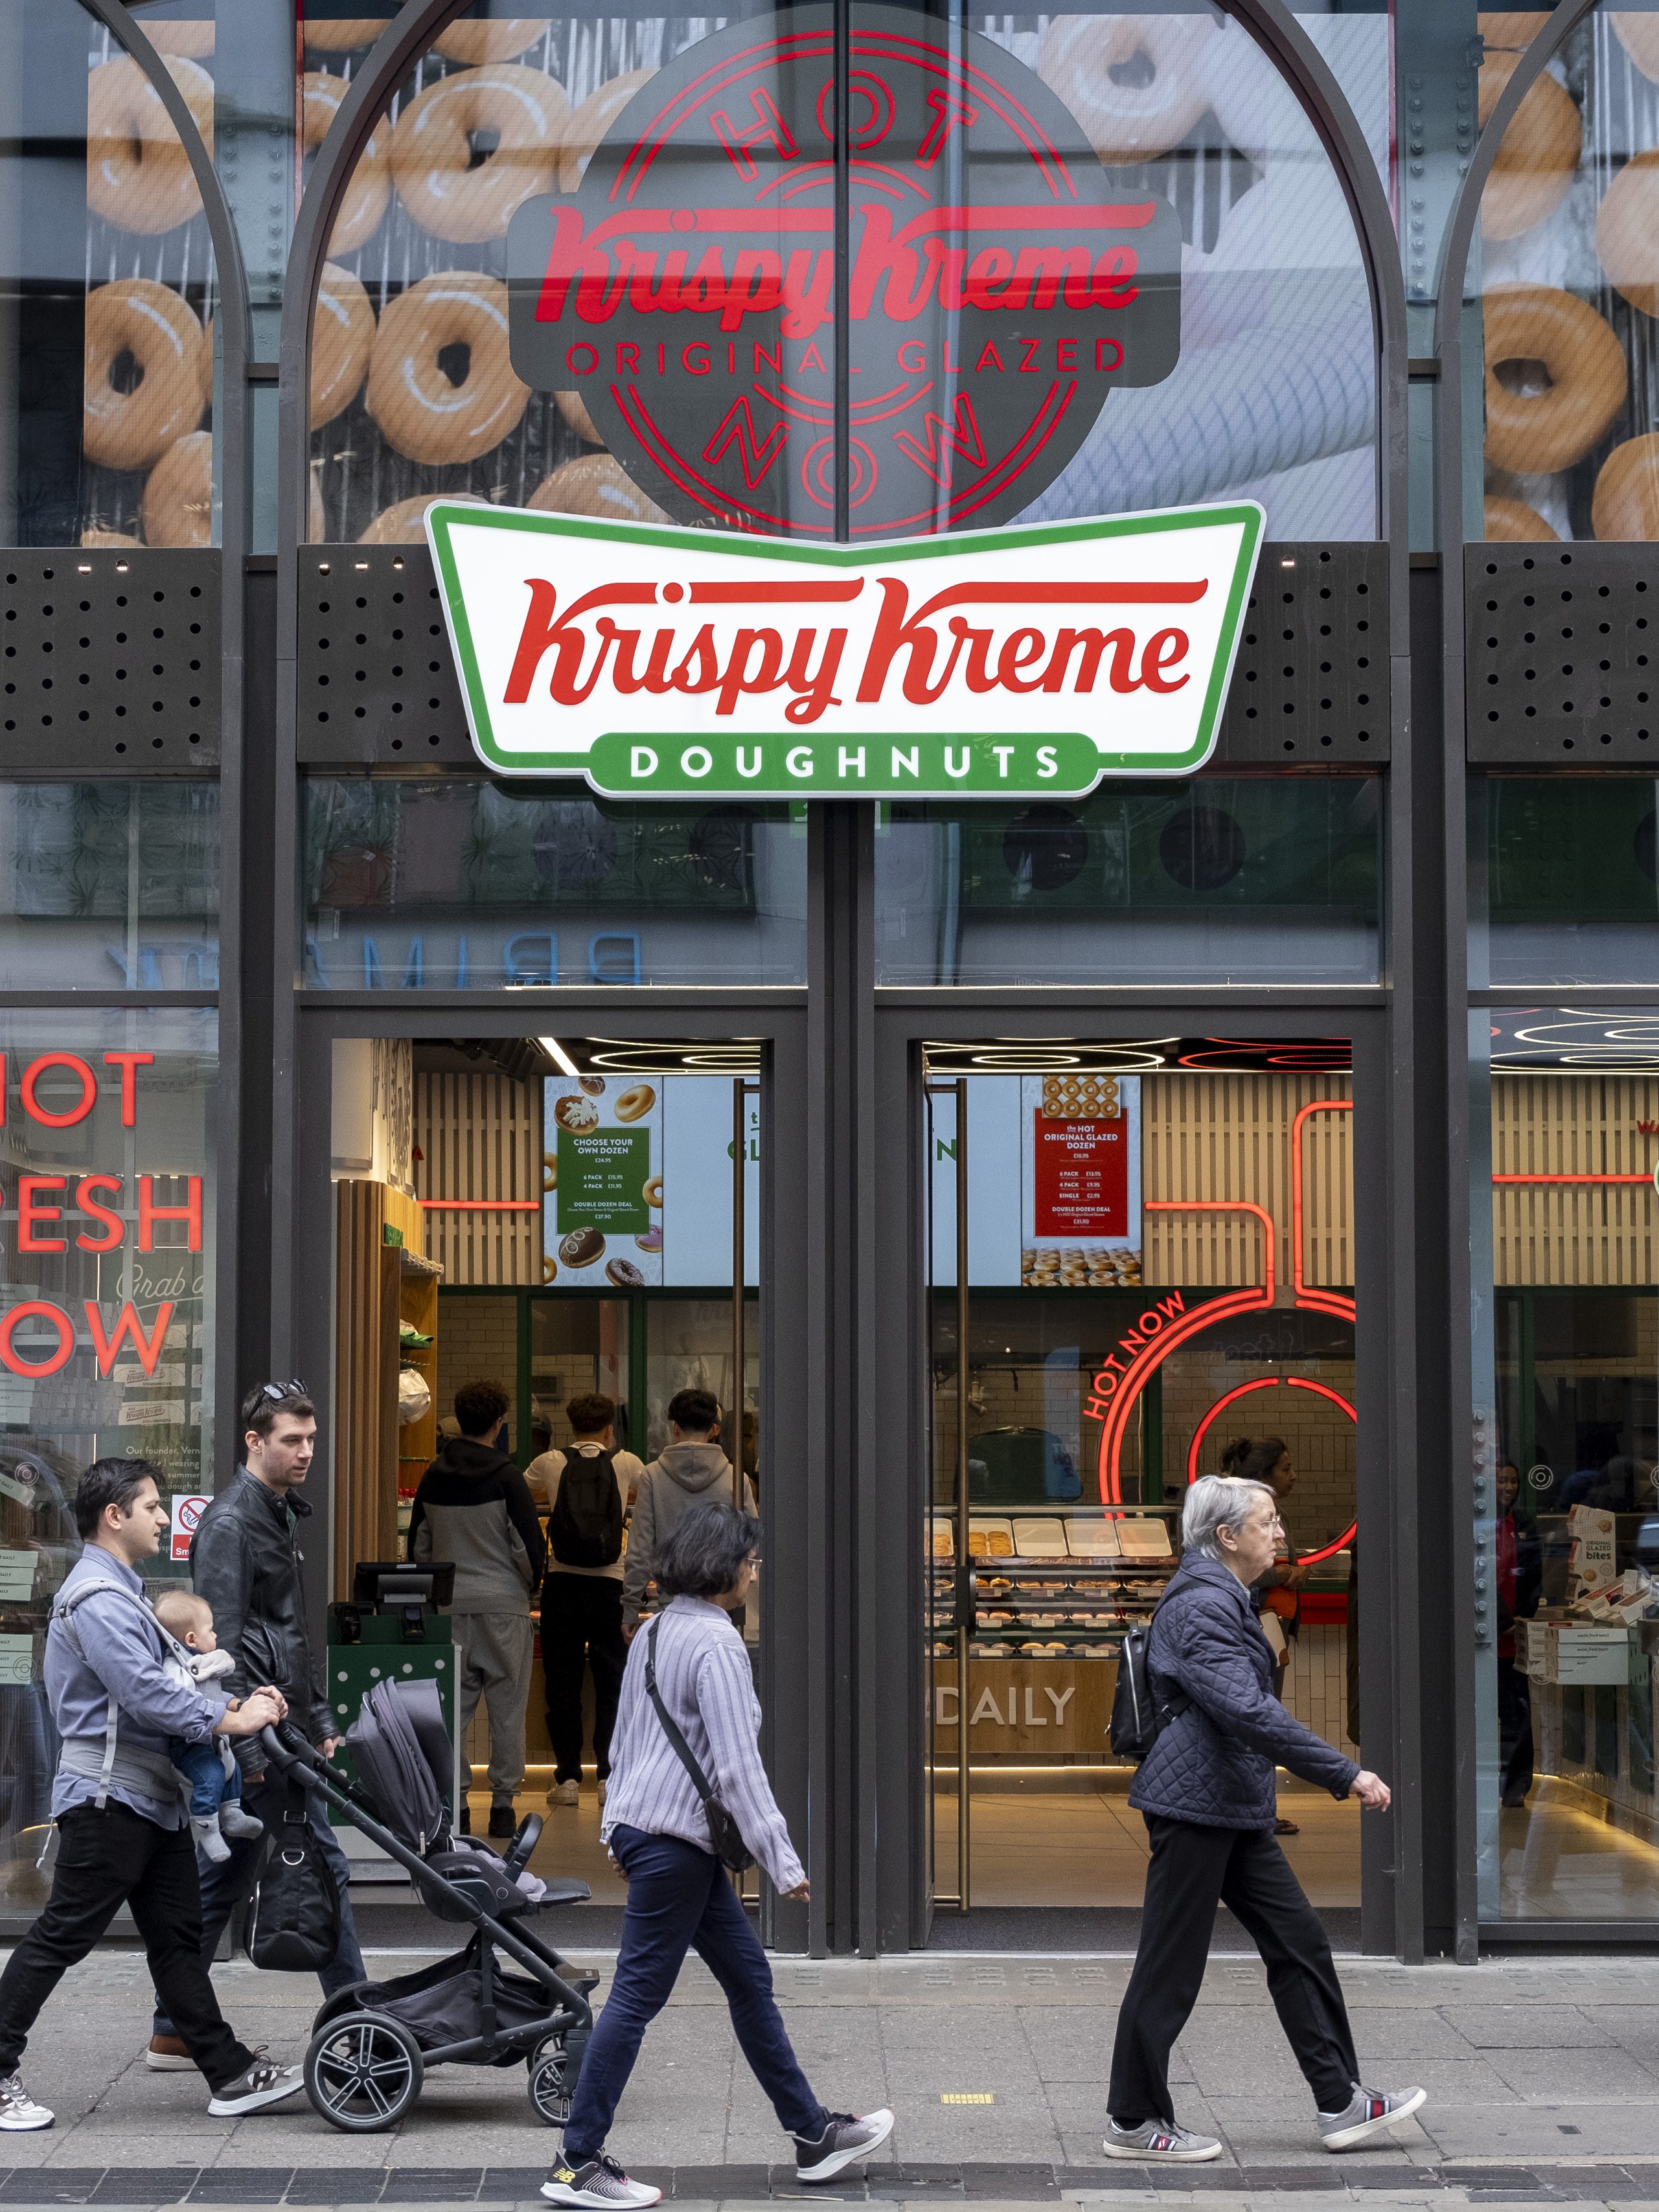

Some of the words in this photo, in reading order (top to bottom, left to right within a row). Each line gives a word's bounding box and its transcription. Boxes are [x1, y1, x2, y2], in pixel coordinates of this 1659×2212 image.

[711, 70, 978, 179] HOT
[535, 206, 836, 339] Krispy
[848, 201, 1156, 322] Kreme
[897, 338, 1124, 374] GLAZED
[703, 393, 987, 510] NOW
[503, 577, 864, 725] Krispy
[856, 577, 1209, 706] Kreme
[631, 746, 1059, 778] DOUGHNUTS
[0, 1052, 154, 1127] OT
[0, 1175, 202, 1251] ESH
[1117, 1289, 1185, 1356] NOW
[1082, 1352, 1128, 1420] HOT
[126, 1446, 143, 1454] Our
[145, 1446, 179, 1455] founder,
[168, 1459, 200, 1470] wearing
[167, 1481, 192, 1492] dough
[1586, 1551, 1611, 1560] bites
[936, 1686, 1076, 1726] DAILY
